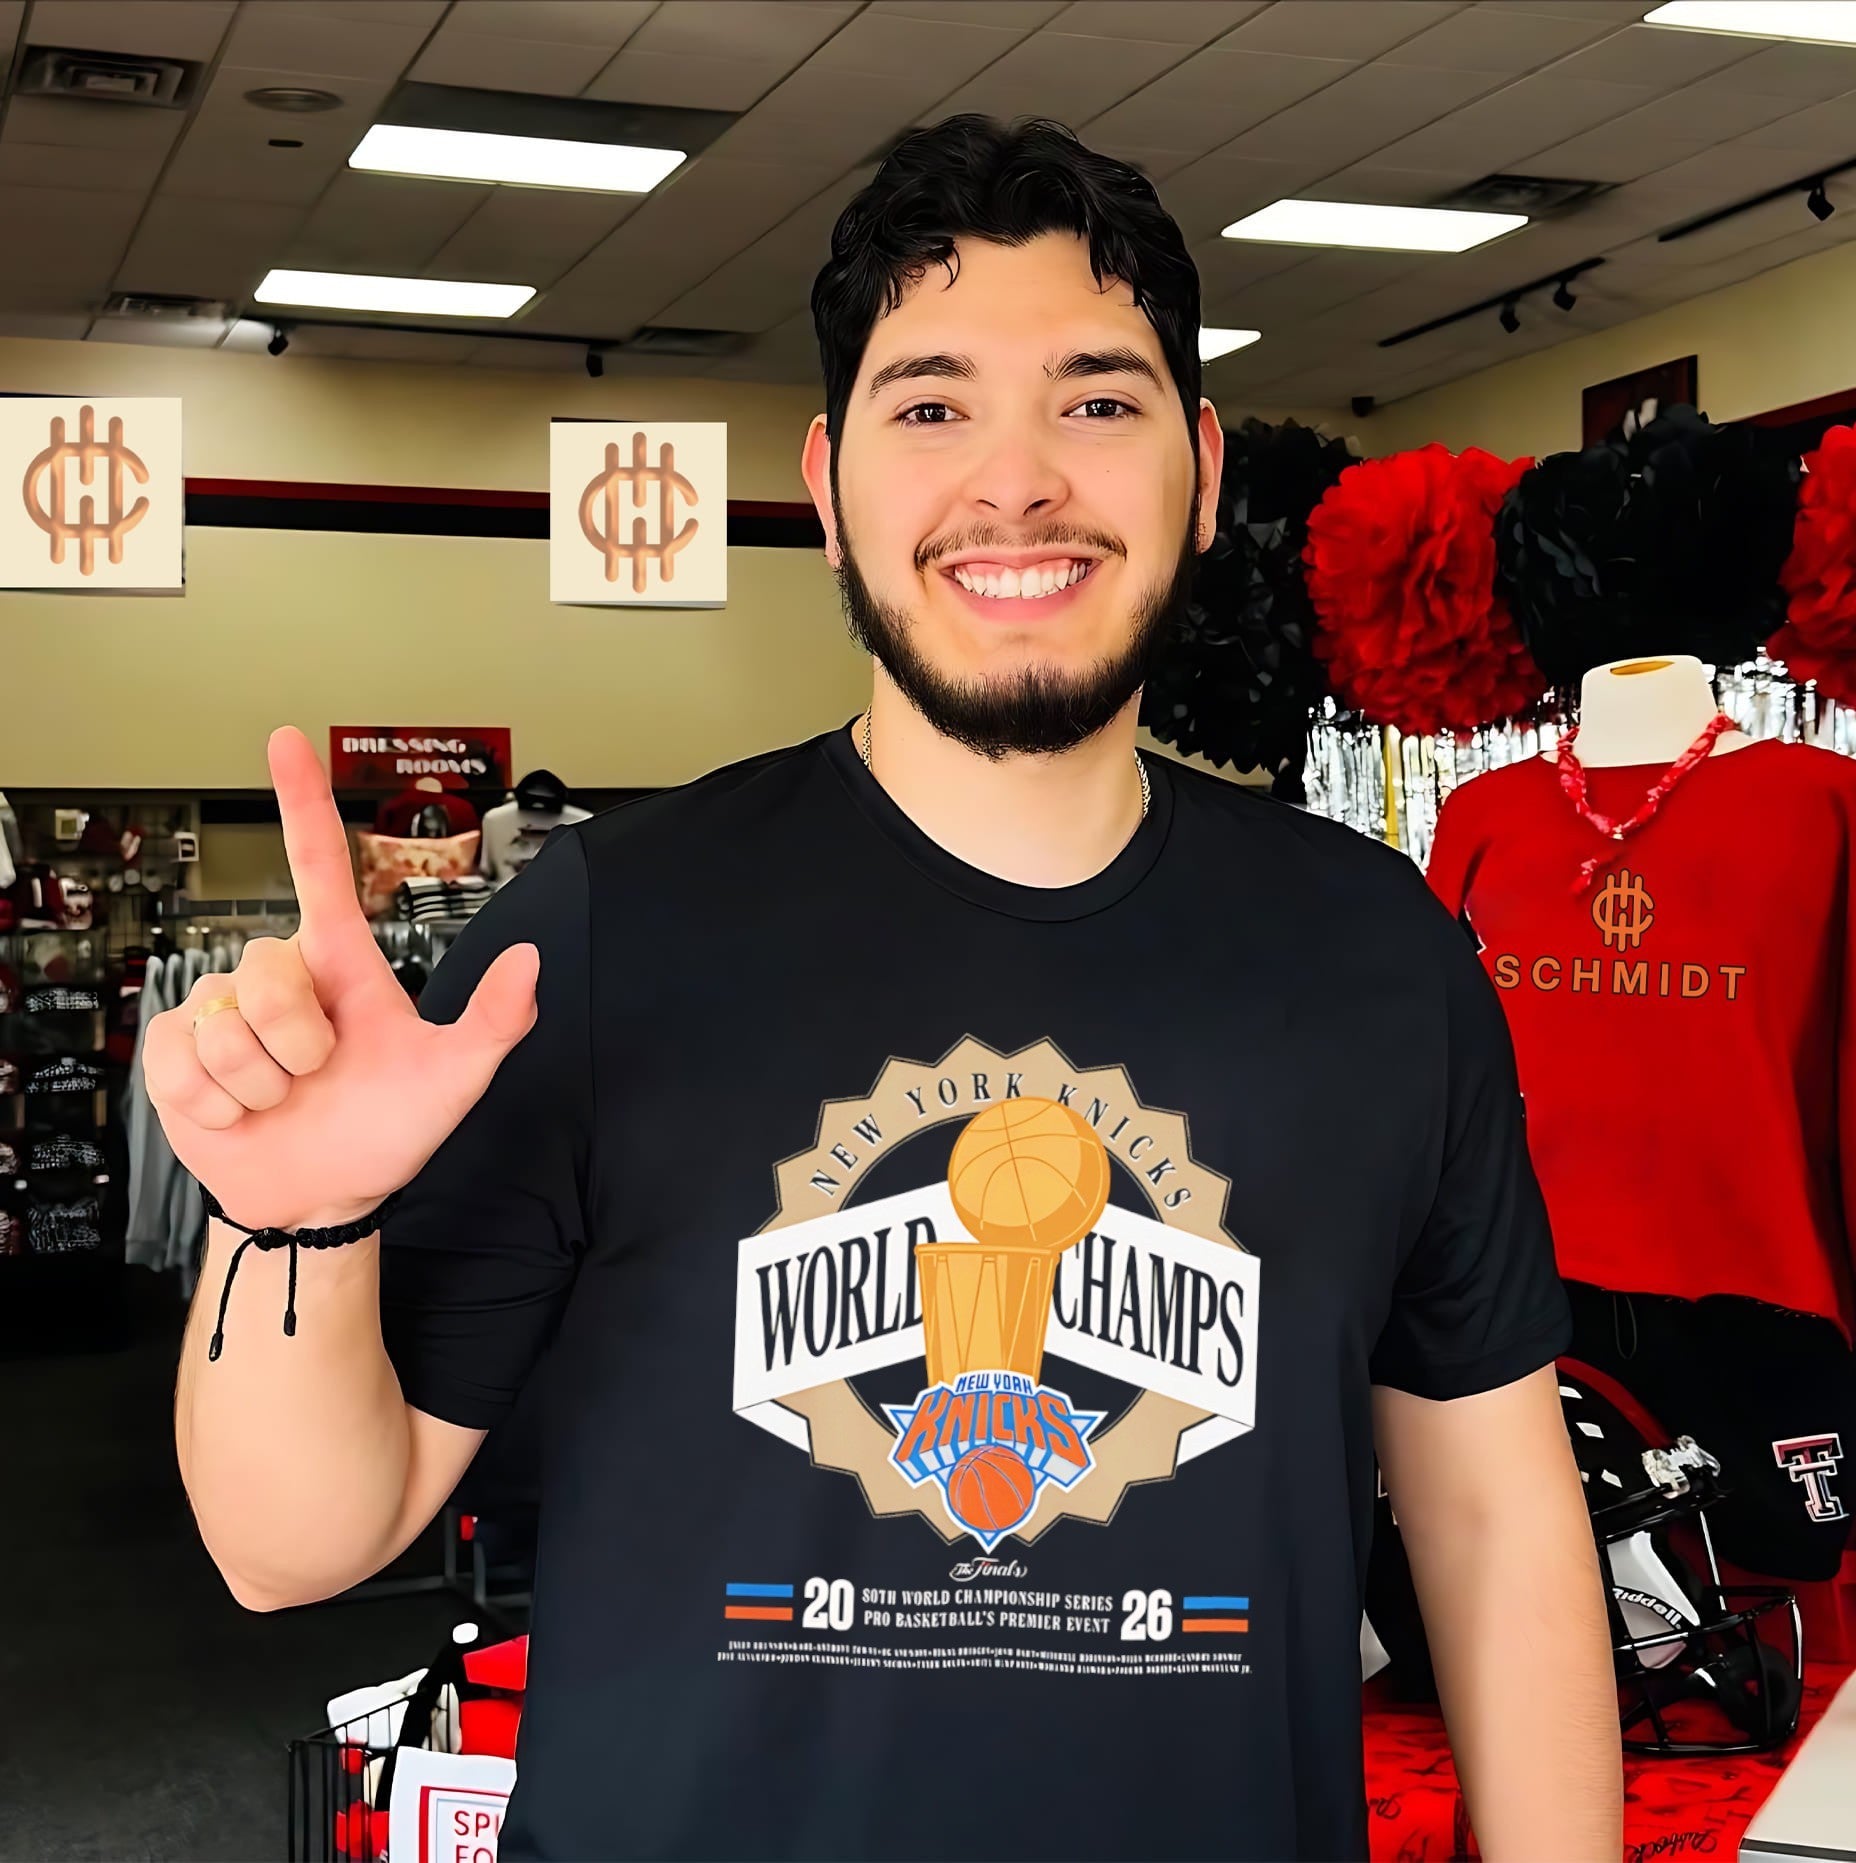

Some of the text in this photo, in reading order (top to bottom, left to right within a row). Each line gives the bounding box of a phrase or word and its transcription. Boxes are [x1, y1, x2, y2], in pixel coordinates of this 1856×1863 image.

[396, 758, 487, 775] ROOMS
[1494, 953, 1747, 1000] SCHMIDT
[808, 1072, 1192, 1210] NEW YORK KNICKS
[1052, 1231, 1246, 1388] CHAMPS
[955, 1373, 1034, 1395] NEW YORK
[895, 1390, 1088, 1468] KNICKS
[802, 1576, 855, 1631] 20
[864, 1610, 1111, 1634] PRO BASKETBALL'S PREMIER EVENT
[901, 1589, 950, 1606] WORLD
[954, 1588, 1061, 1609] CHAMPIONSHIP
[1064, 1594, 1113, 1612] SERIES
[1120, 1589, 1173, 1641] 26
